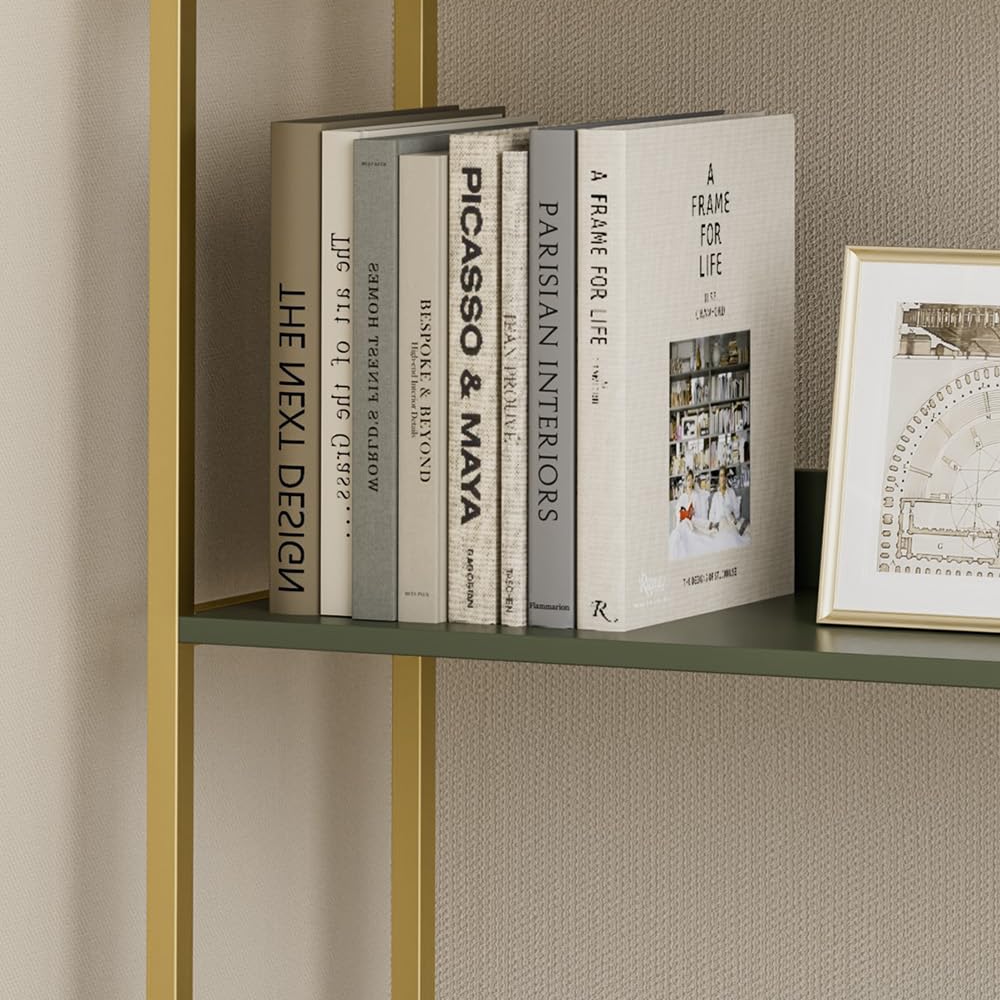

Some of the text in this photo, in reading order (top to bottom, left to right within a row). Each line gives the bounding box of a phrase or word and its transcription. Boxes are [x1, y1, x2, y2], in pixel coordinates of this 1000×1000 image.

[590, 170, 608, 182] A
[706, 162, 715, 185] A
[691, 191, 730, 216] FRAME
[590, 194, 608, 255] FRAME
[700, 222, 722, 247] FOR
[699, 252, 722, 278] LIFE
[590, 266, 608, 301] FOR
[589, 309, 608, 345] LIFE
[459, 166, 484, 526] PICASSO & MAYA
[537, 202, 559, 522] PARISIAN INTERIORS
[419, 299, 432, 483] BESPOKE & BEYOND
[528, 602, 570, 612] Flammarion
